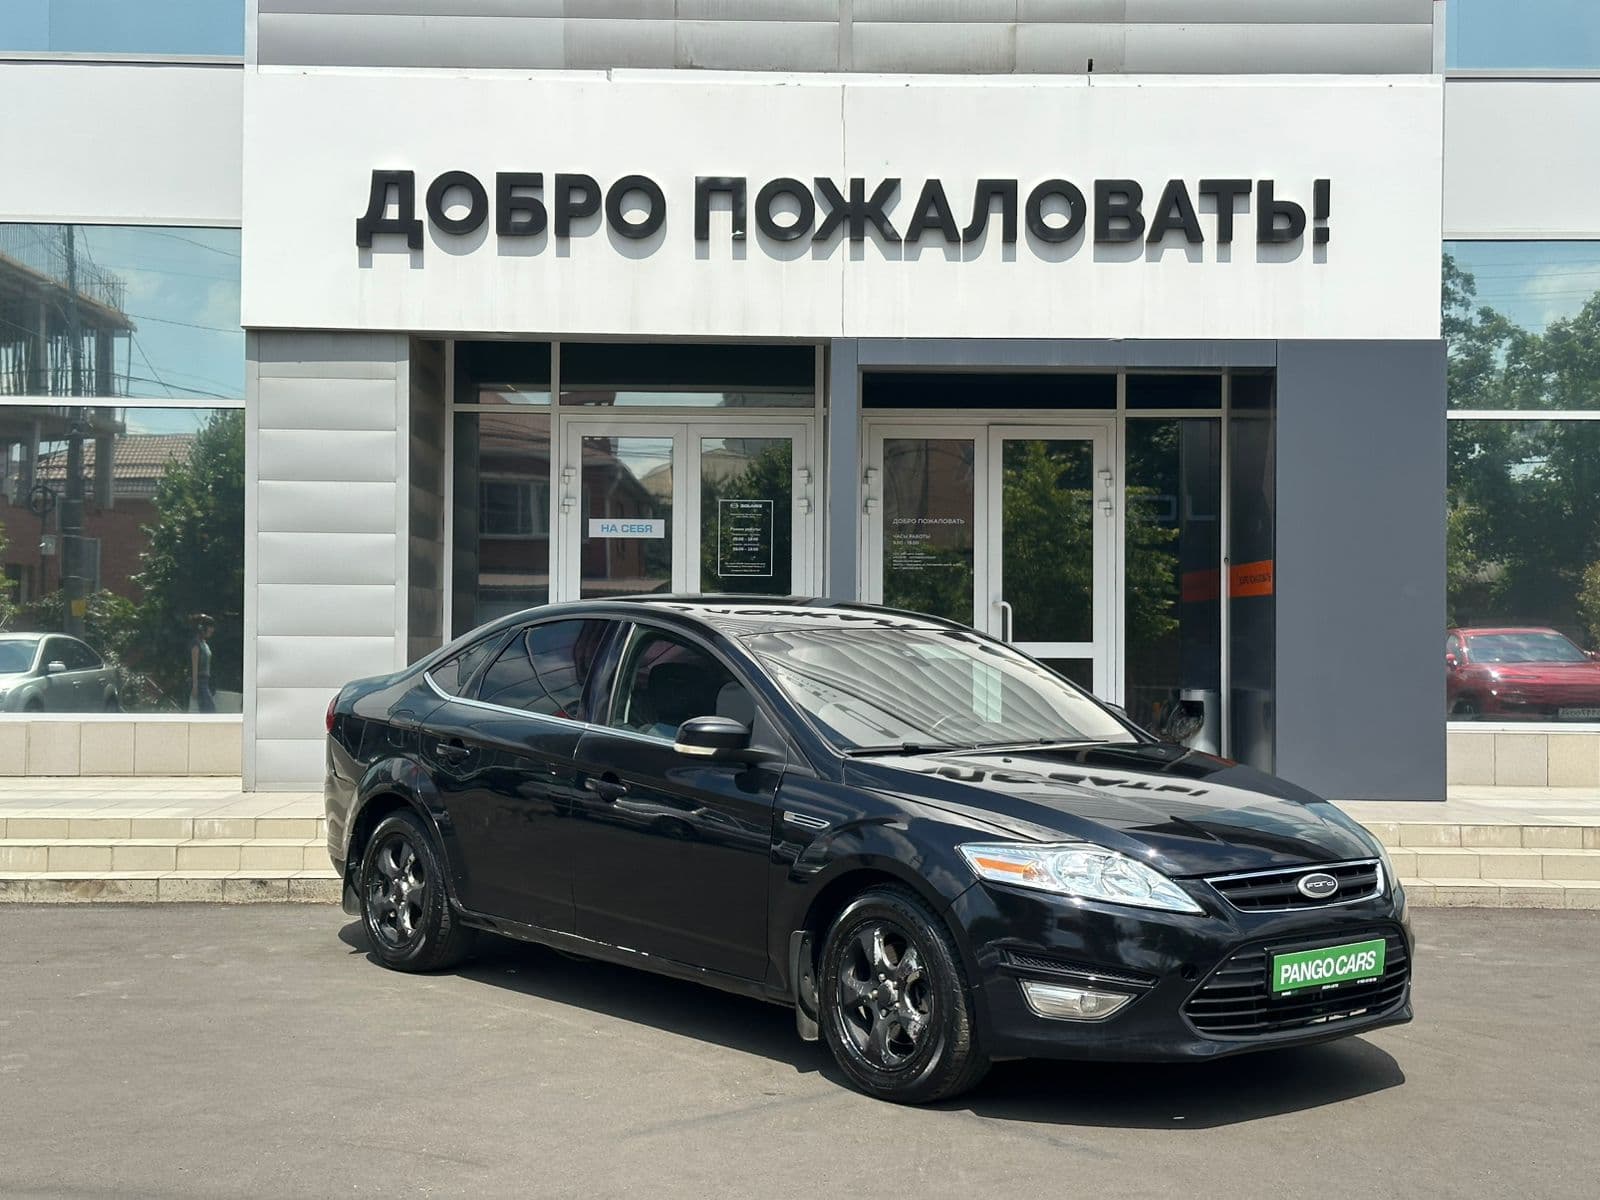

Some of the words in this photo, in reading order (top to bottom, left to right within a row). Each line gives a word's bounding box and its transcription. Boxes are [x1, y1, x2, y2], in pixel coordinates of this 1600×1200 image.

[356, 169, 667, 250] ДОБРО
[694, 176, 1331, 244] ПОЖАЛОВАТЬ!
[600, 523, 619, 534] НА
[621, 523, 653, 534] СЕБЯ
[1280, 957, 1335, 985] PANGO
[1335, 950, 1377, 976] CARS
